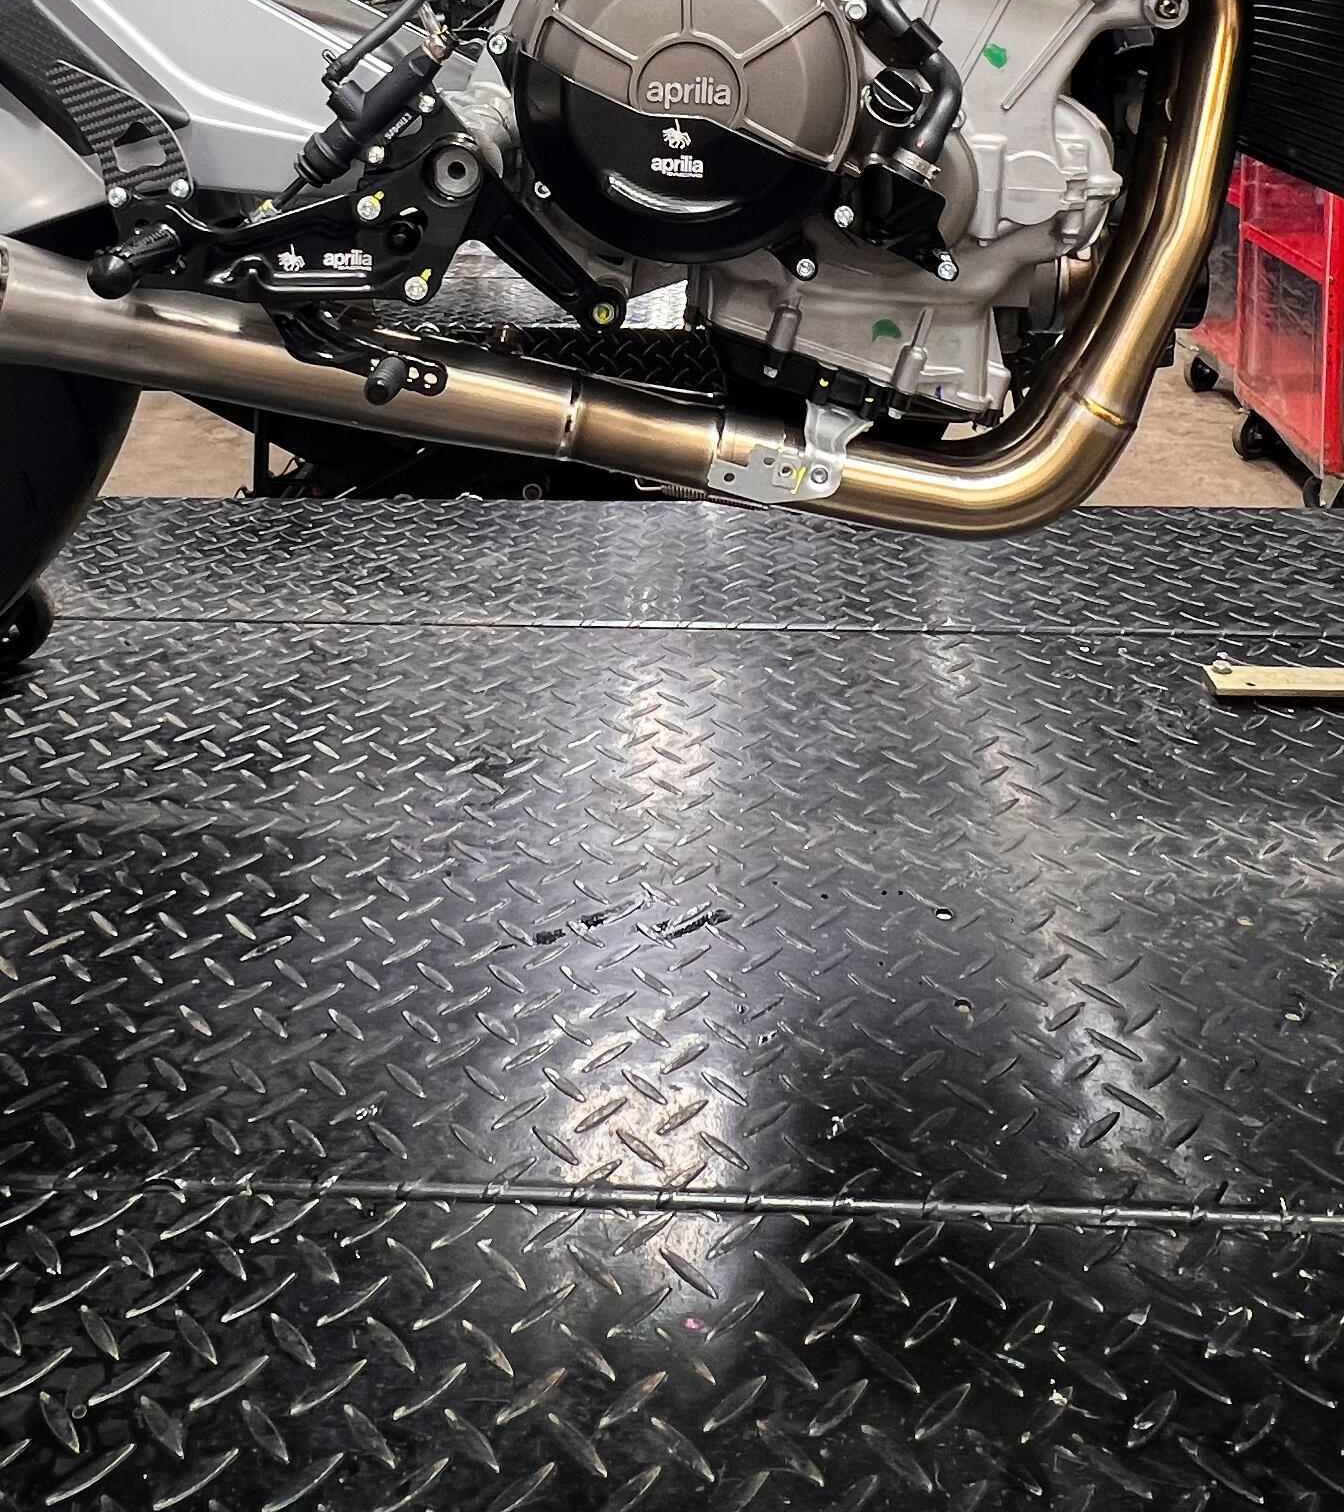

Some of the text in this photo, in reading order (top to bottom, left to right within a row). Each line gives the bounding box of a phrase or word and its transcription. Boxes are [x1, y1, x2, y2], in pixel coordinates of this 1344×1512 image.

[646, 76, 732, 110] aprilia
[650, 154, 704, 175] aprilia
[322, 248, 373, 269] aprilia
